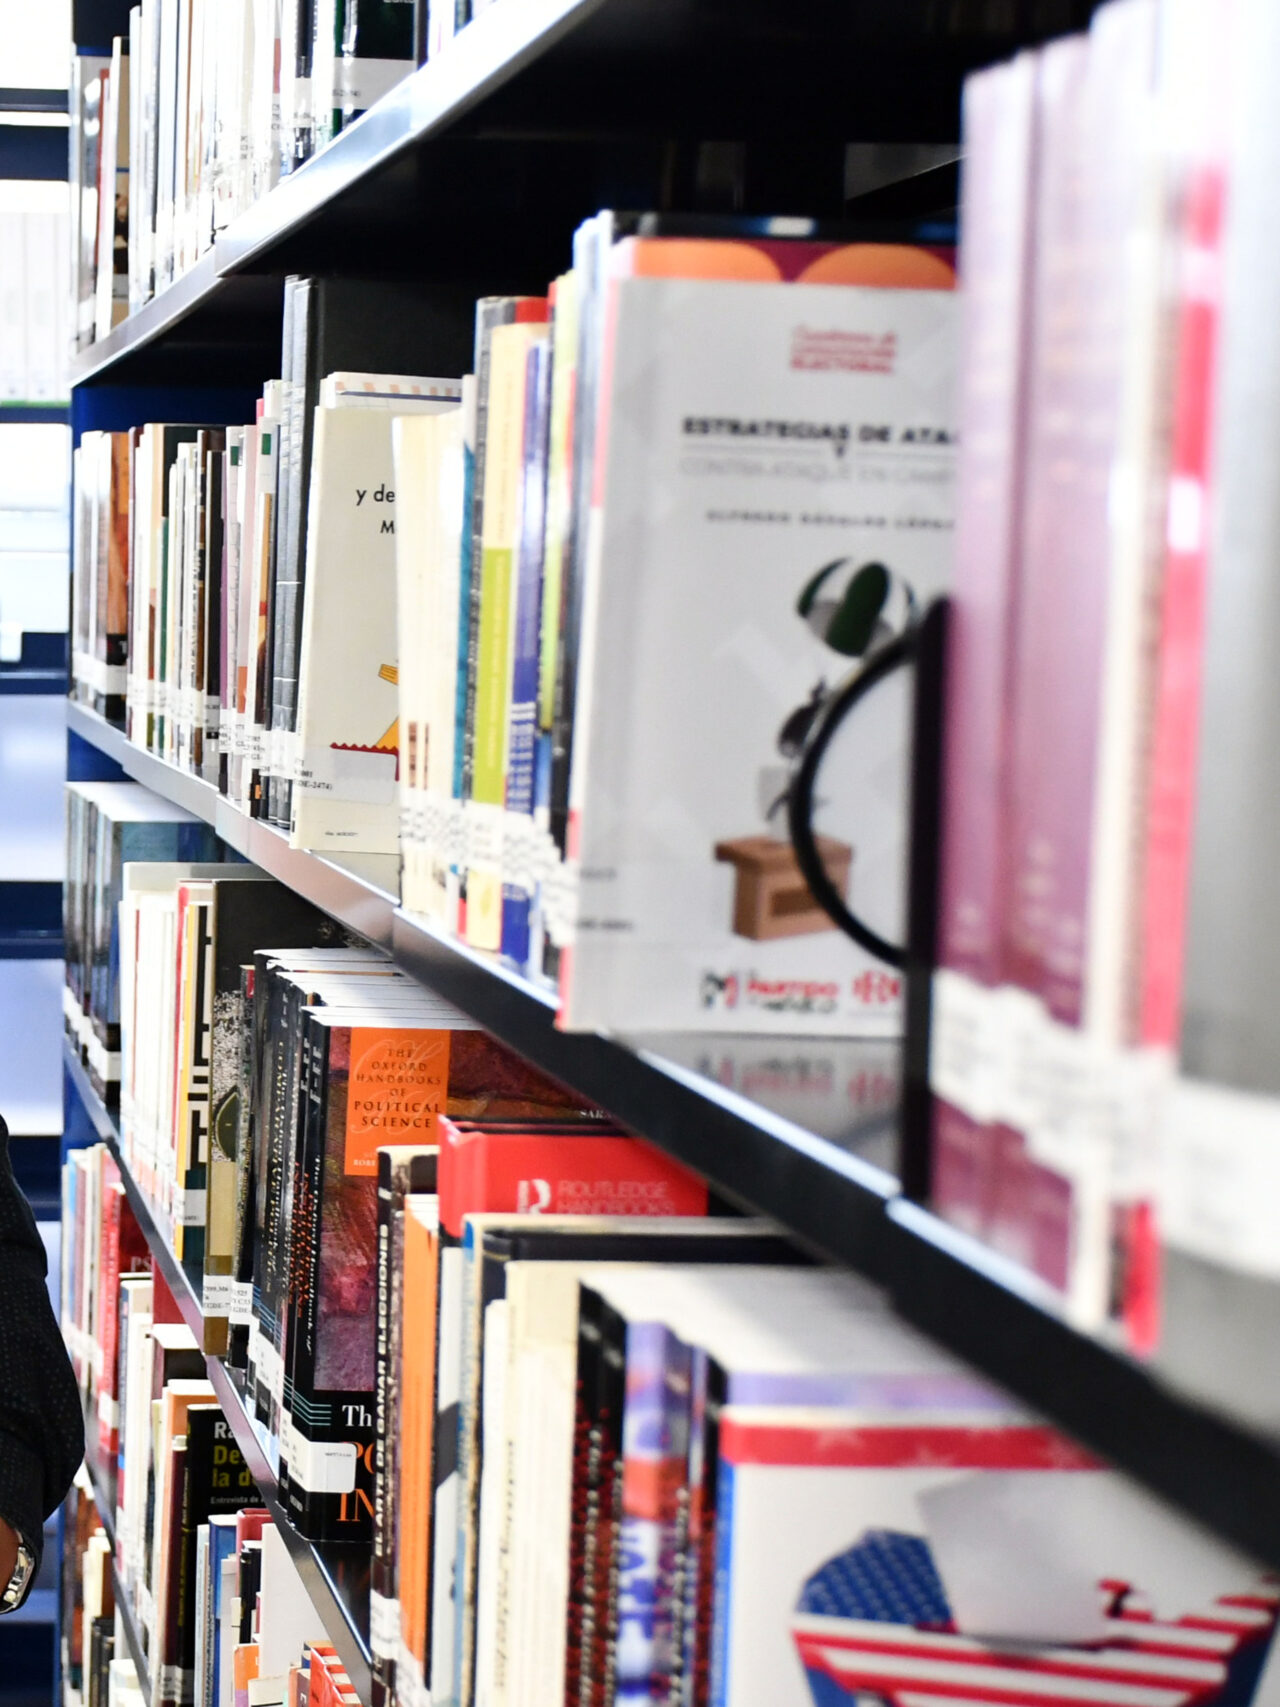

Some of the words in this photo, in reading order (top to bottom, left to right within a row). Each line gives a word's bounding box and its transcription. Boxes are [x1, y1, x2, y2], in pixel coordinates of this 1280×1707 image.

[683, 416, 849, 441] ESTRATEGIAS
[859, 424, 891, 443] DE
[900, 427, 955, 446] ATA
[356, 489, 367, 507] y
[388, 1048, 413, 1058] THE
[371, 1061, 428, 1072] OXFORD
[355, 1073, 442, 1086] HANDBOOKS
[389, 1088, 407, 1097] OF
[353, 1100, 442, 1114] POLITICAL
[361, 1115, 432, 1129] SCIENCE
[556, 1179, 670, 1199] ROUTLEDGE
[376, 1358, 386, 1434] GANAR
[342, 1405, 372, 1427] Th
[214, 1445, 248, 1465] De
[375, 1438, 384, 1467] DE
[212, 1468, 230, 1487] la
[375, 1471, 384, 1527] ARTE
[374, 1531, 383, 1556] EL
